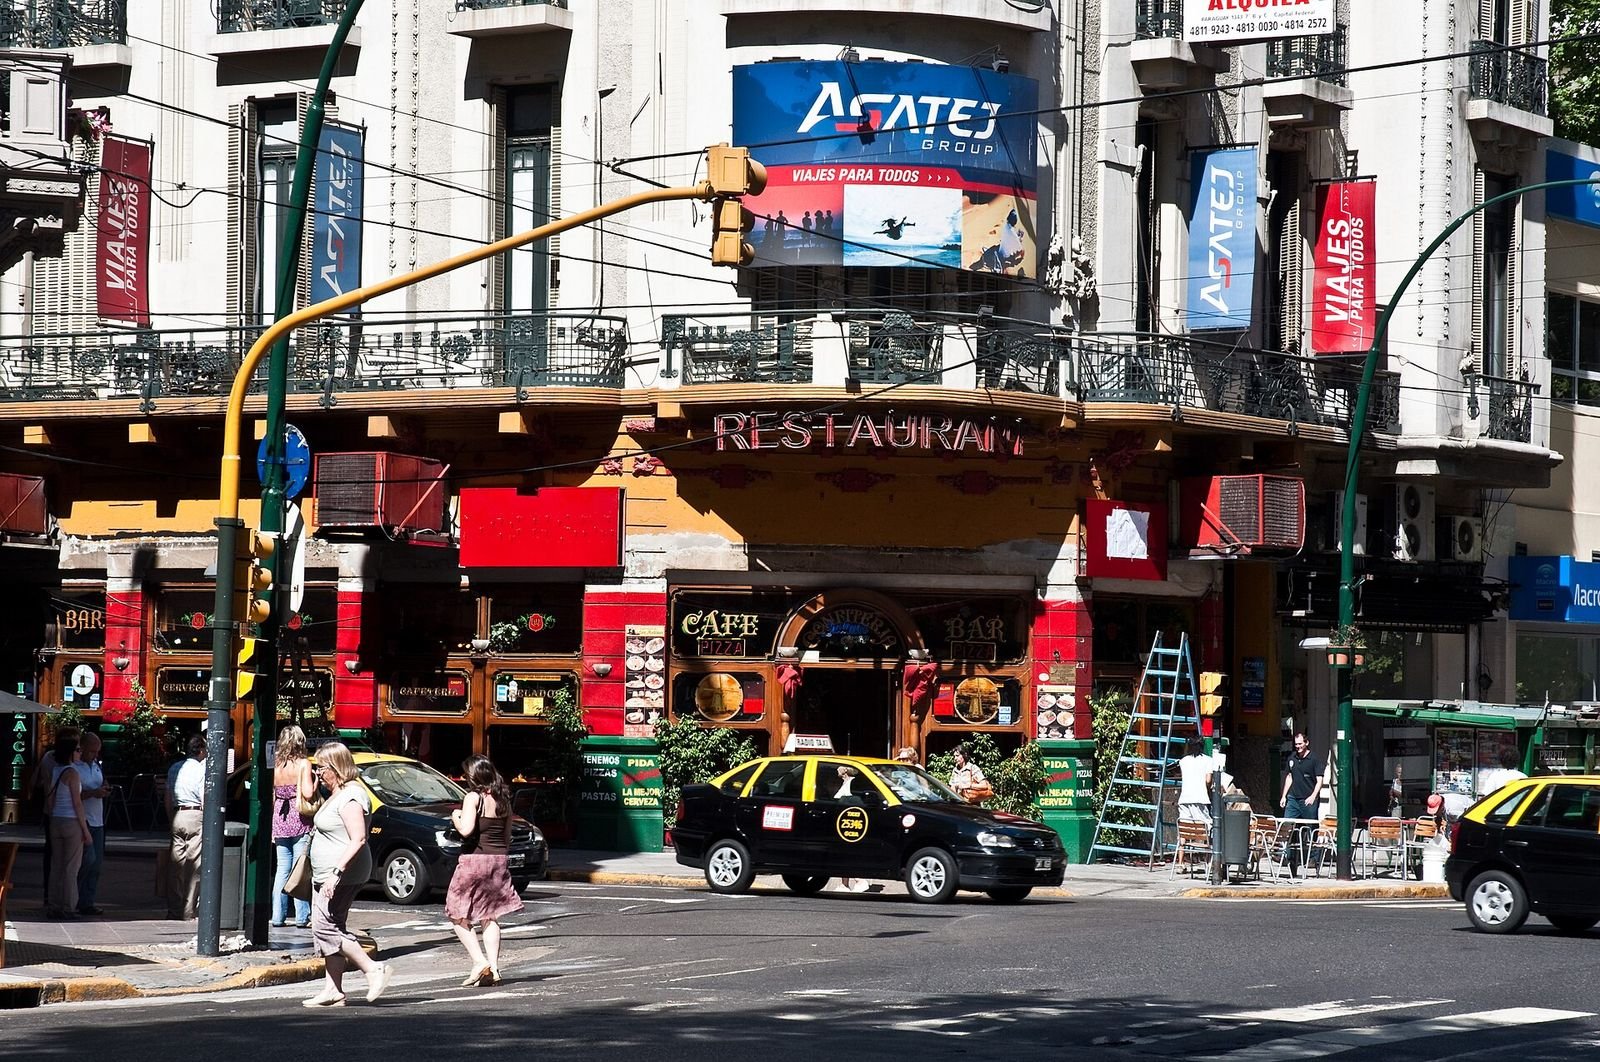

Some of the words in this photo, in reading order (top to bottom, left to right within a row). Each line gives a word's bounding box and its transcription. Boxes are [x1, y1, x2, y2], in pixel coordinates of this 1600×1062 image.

[1208, 0, 1310, 12] ALQUILA
[1189, 26, 1208, 36] 4811
[1210, 24, 1230, 35] 9243
[1236, 22, 1255, 33] 4813
[1258, 20, 1278, 32] 0030
[1284, 19, 1304, 30] 4814
[1307, 17, 1327, 29] 2572
[797, 82, 1002, 140] ASATEJ
[921, 139, 994, 155] GROUP
[792, 168, 836, 183] VIAJES
[838, 168, 875, 182] PARA
[878, 168, 920, 183] TODOS
[1235, 170, 1244, 229] GROUP
[127, 180, 139, 238] TODOS
[320, 138, 348, 296] ASATEJ
[106, 176, 129, 291] VIAJES
[1200, 164, 1234, 316] ASATEJ
[1351, 217, 1364, 271] TODOS
[126, 246, 138, 291] PARA
[1325, 217, 1350, 322] VIAJES
[1350, 277, 1364, 321] PARA
[64, 609, 105, 634] BAR
[681, 609, 759, 638] CAFE
[943, 614, 1007, 643] BAR
[701, 640, 743, 656] PIZZA
[953, 643, 995, 659] PIZZA
[163, 682, 208, 693] CERVECE
[796, 737, 815, 747] RADIO
[815, 738, 829, 748] TAXI
[583, 755, 620, 765] TENEMOS
[627, 758, 655, 767] PIDA
[1538, 750, 1565, 761] PERFIL
[1043, 760, 1070, 769] PIDA
[584, 767, 618, 778] PIZZAS
[1076, 769, 1093, 778] PIZZAS
[595, 780, 601, 788] Y
[581, 791, 617, 802] PASTAS
[622, 787, 633, 796] LA
[634, 787, 660, 797] MEJOR
[1049, 788, 1075, 797] MEJOR
[1076, 788, 1093, 798] PASTAS
[623, 797, 659, 807] CERVEZA
[1039, 797, 1073, 807] CERVEZA
[840, 818, 864, 830] 25346
